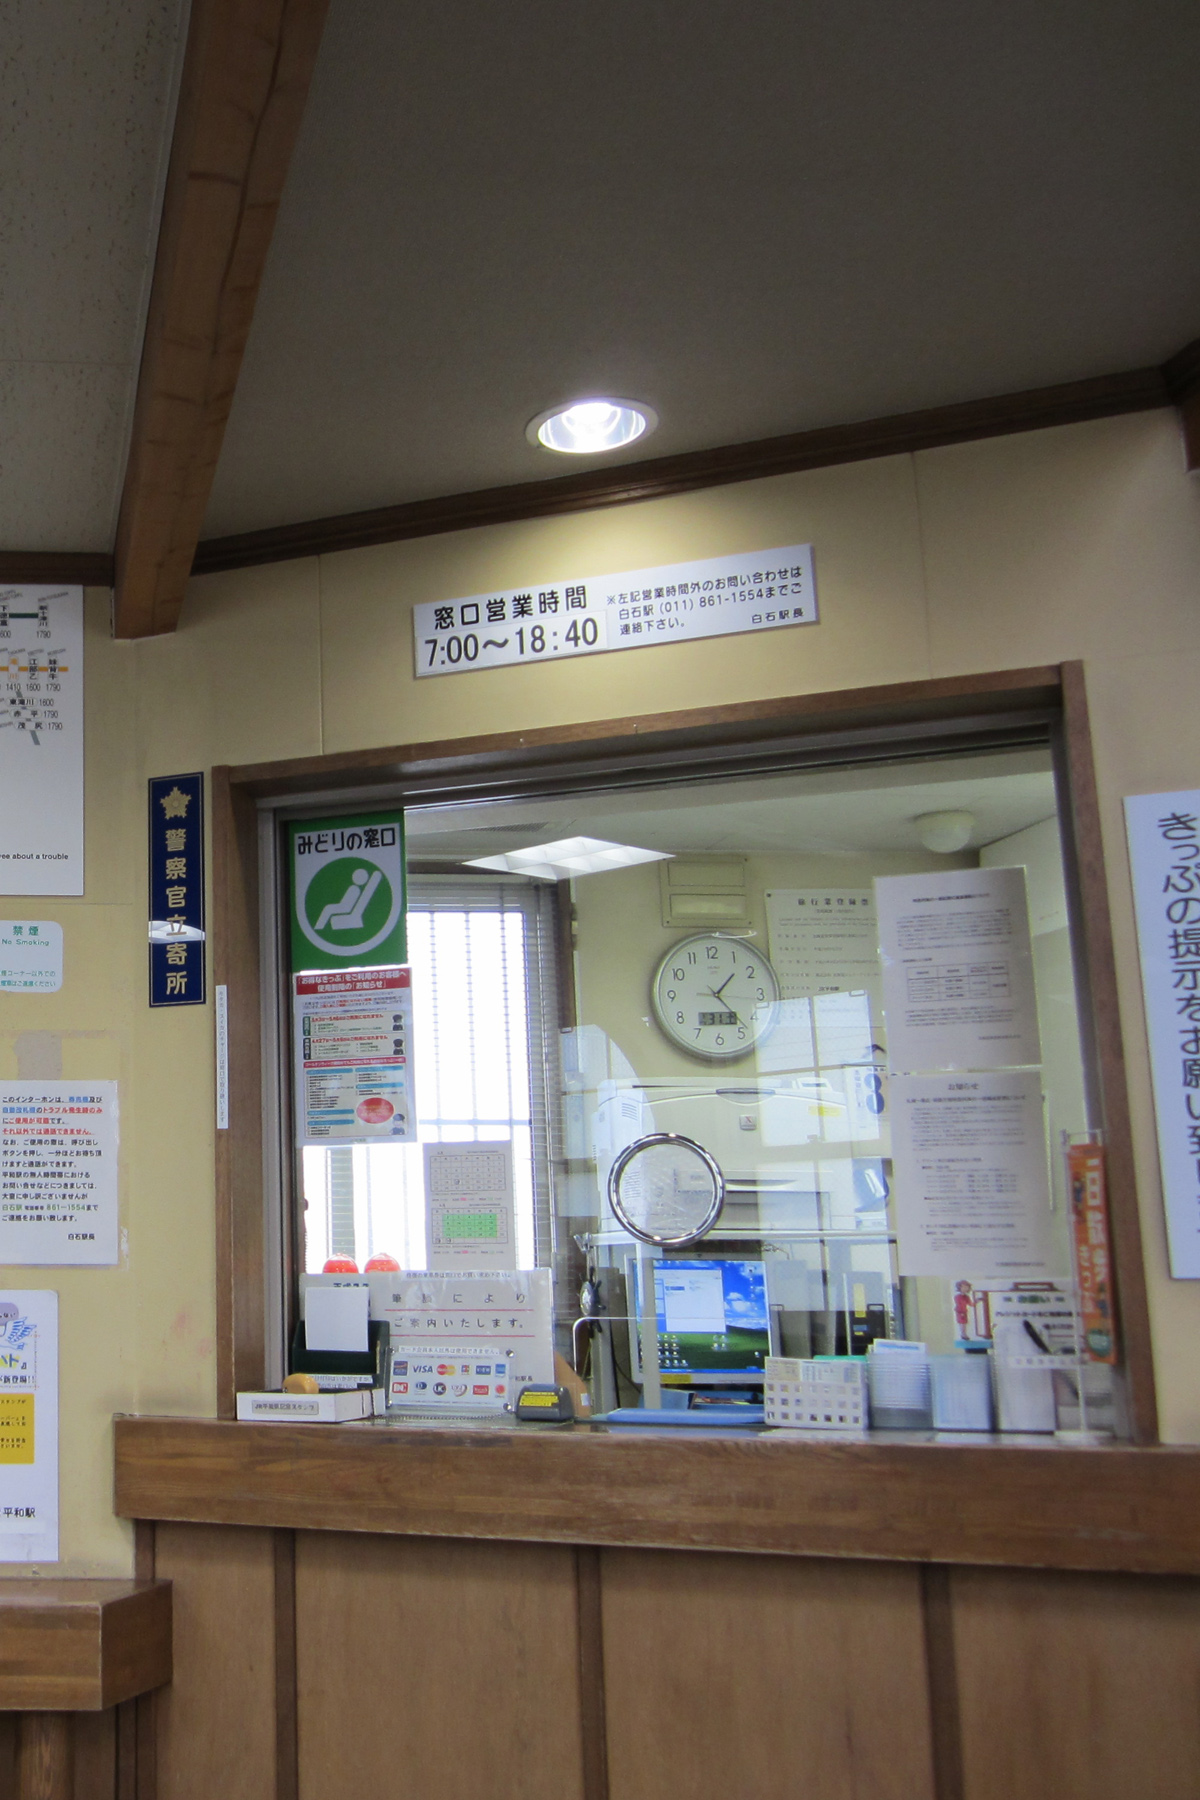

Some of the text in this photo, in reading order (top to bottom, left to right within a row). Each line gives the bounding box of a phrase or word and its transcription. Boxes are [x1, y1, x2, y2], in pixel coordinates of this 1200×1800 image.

[433, 584, 587, 630] 窓口営業時間
[619, 604, 654, 620] 白石駅
[752, 608, 803, 624] 白石駅長
[619, 617, 685, 635] 連絡下さい。
[297, 828, 396, 855] みどりの窓口
[165, 828, 187, 995] 警察官立寄所
[13, 926, 39, 936] 禁煙
[688, 952, 696, 964] 11
[706, 946, 718, 959] 12
[672, 968, 685, 981] 10
[746, 966, 755, 979] 2
[667, 990, 676, 1002] 9
[756, 988, 765, 1001] 3
[677, 1011, 684, 1024] 8
[750, 1011, 759, 1021] 4
[694, 1028, 701, 1039] 7
[715, 1033, 724, 1045] 6
[738, 1027, 746, 1039] 5
[394, 1318, 523, 1328] ご案内いたします。
[413, 1365, 433, 1374] VISA
